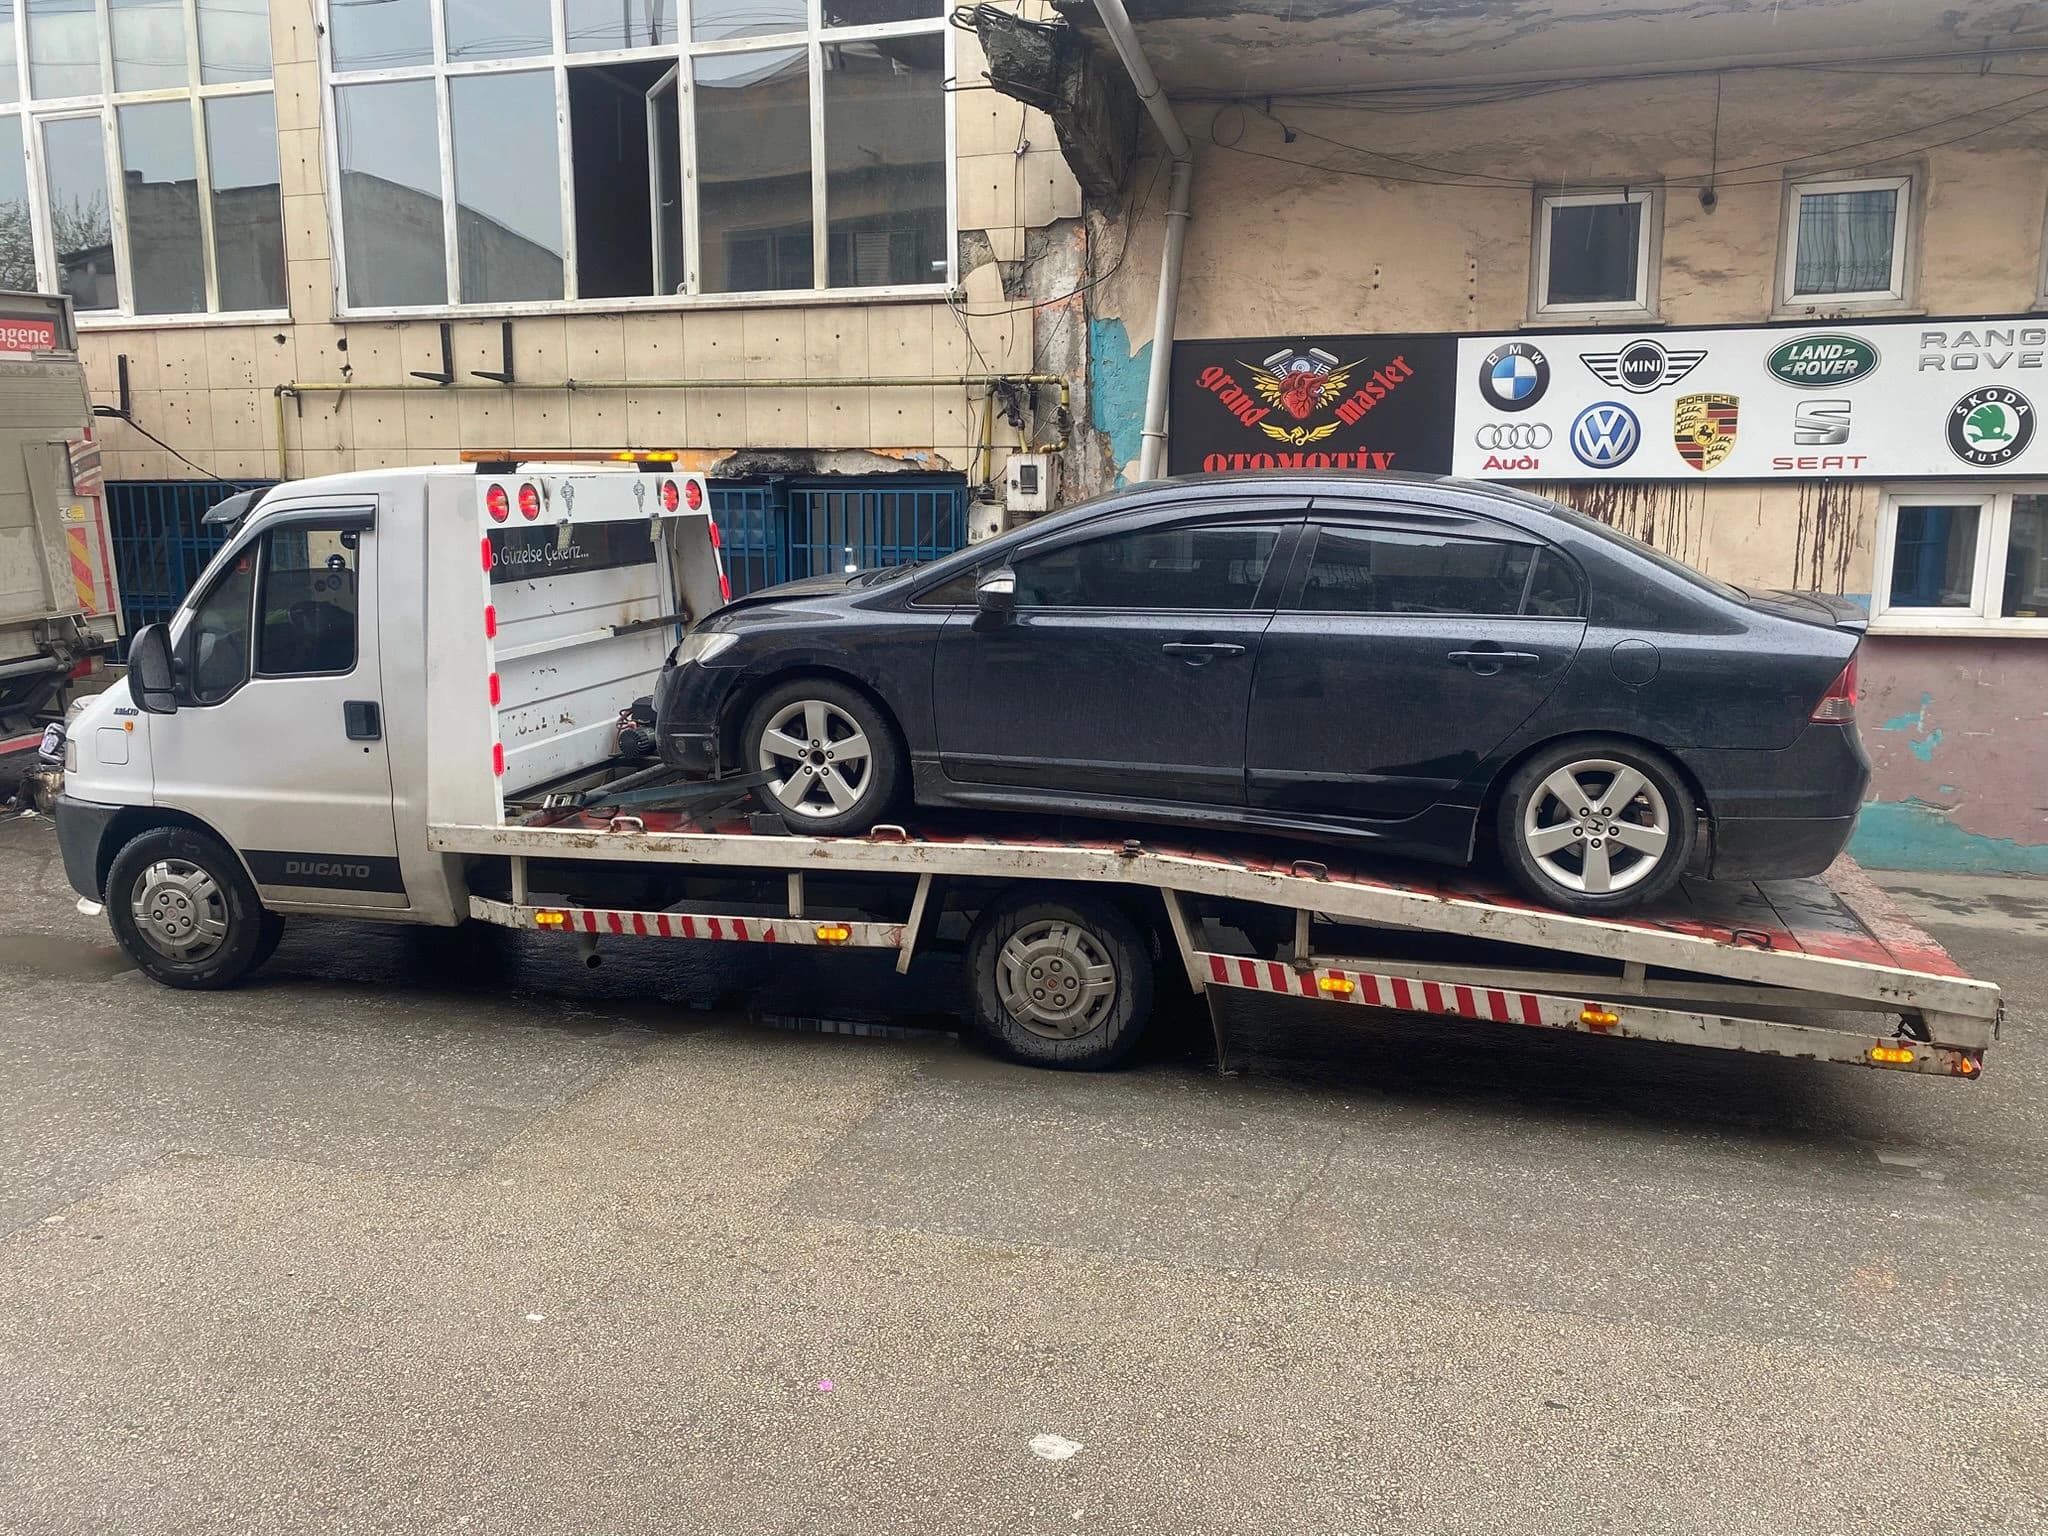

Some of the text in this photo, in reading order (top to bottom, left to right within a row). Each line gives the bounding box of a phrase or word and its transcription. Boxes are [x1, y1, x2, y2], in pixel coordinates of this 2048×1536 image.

[1486, 343, 1545, 367] BMW
[1789, 344, 1842, 359] LAND
[1624, 359, 1662, 374] MINI
[1791, 359, 1859, 376] ROVER
[1195, 365, 1271, 427] grand
[1333, 355, 1415, 427] master
[1676, 394, 1738, 408] PORSCHE
[1956, 389, 2029, 417] SKODA
[1481, 454, 1540, 471] Audi
[1772, 455, 1868, 471] SEAT
[1965, 448, 2012, 463] AUTO
[500, 543, 543, 566] Güzelse
[286, 861, 370, 878] DUCATO
